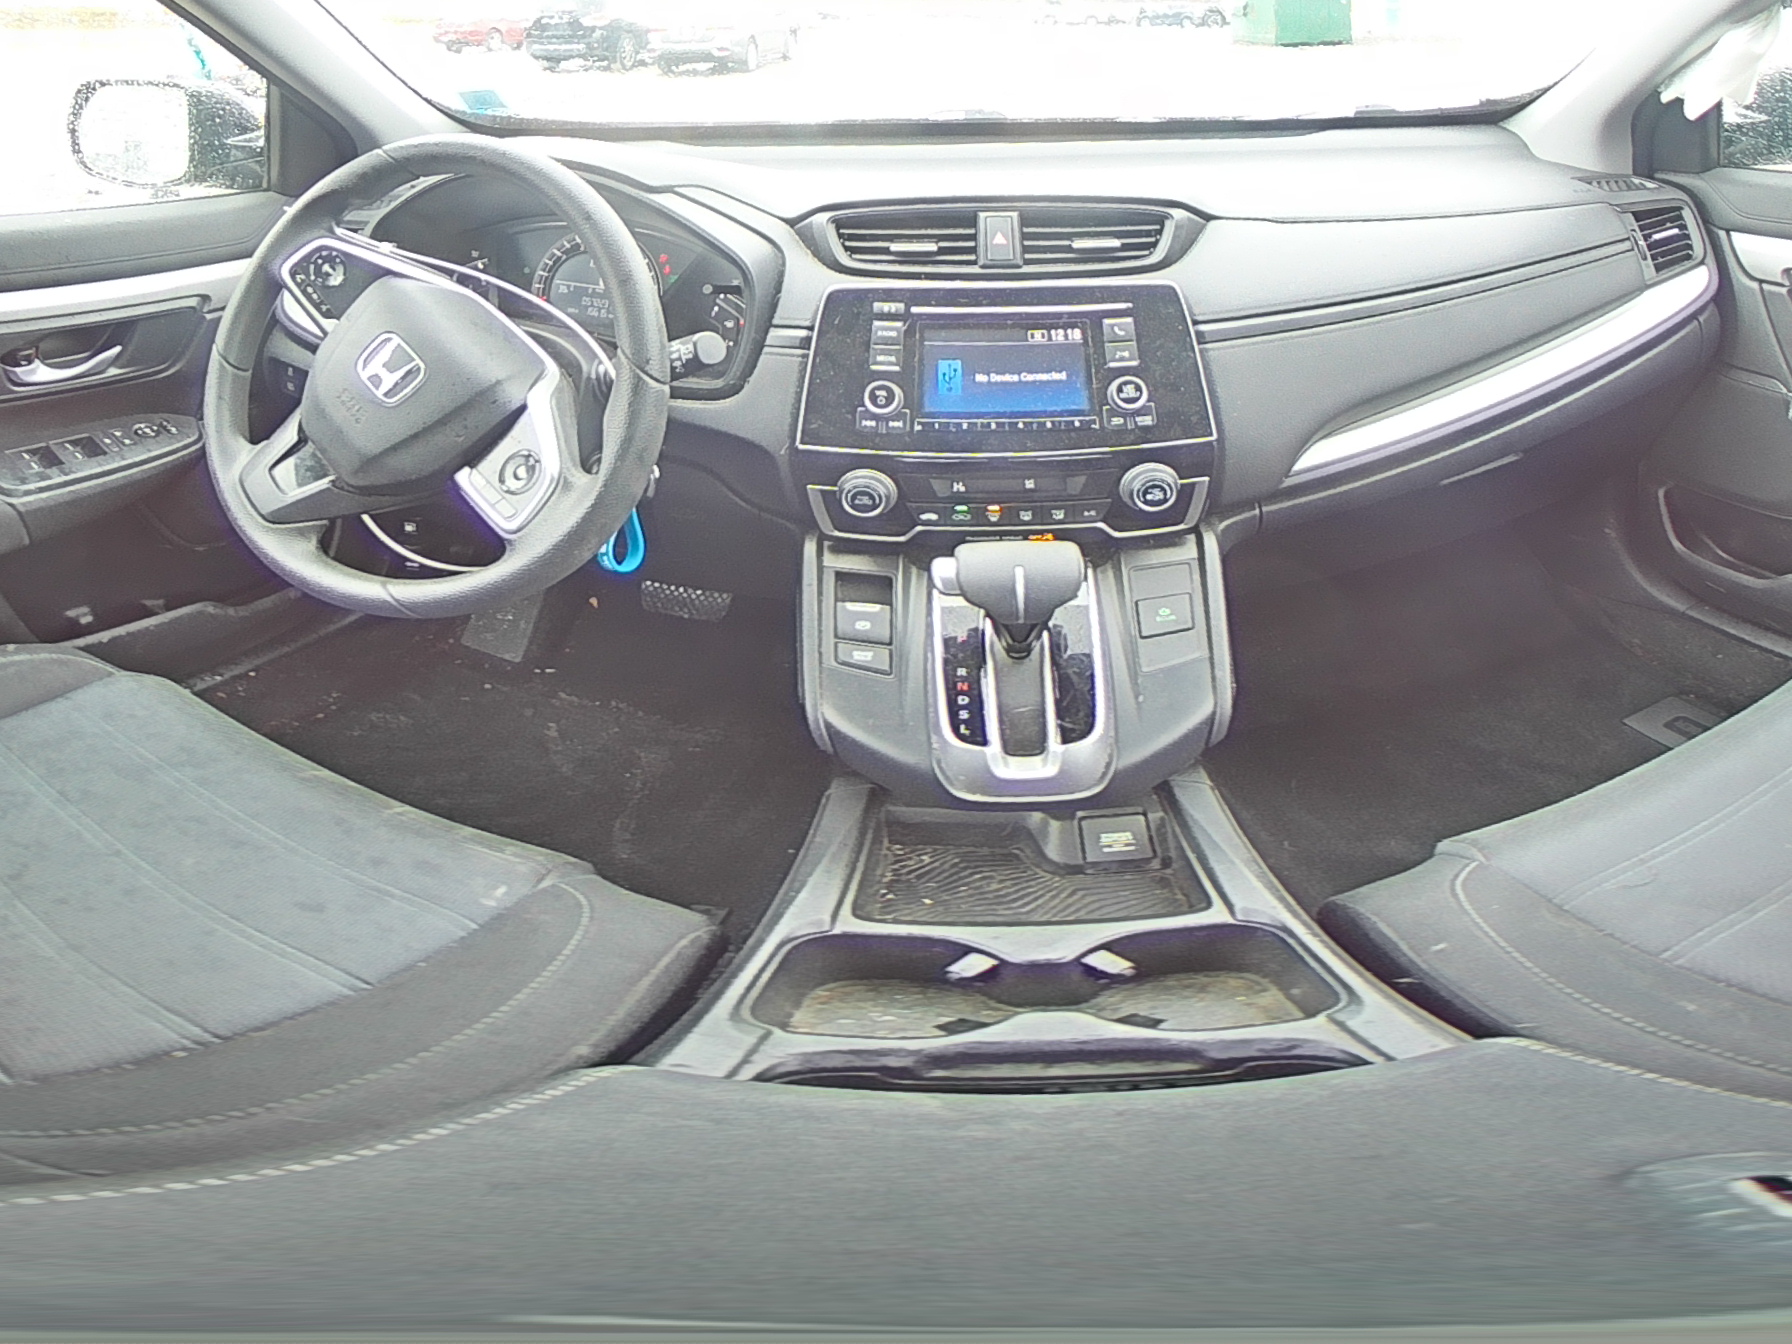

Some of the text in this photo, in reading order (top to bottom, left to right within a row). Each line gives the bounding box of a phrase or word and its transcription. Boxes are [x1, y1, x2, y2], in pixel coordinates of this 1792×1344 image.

[975, 370, 1067, 382] No Device Connected
[956, 667, 968, 676] R
[957, 682, 970, 691] N
[957, 695, 970, 705] D
[958, 710, 970, 719] S
[959, 724, 970, 736] L
